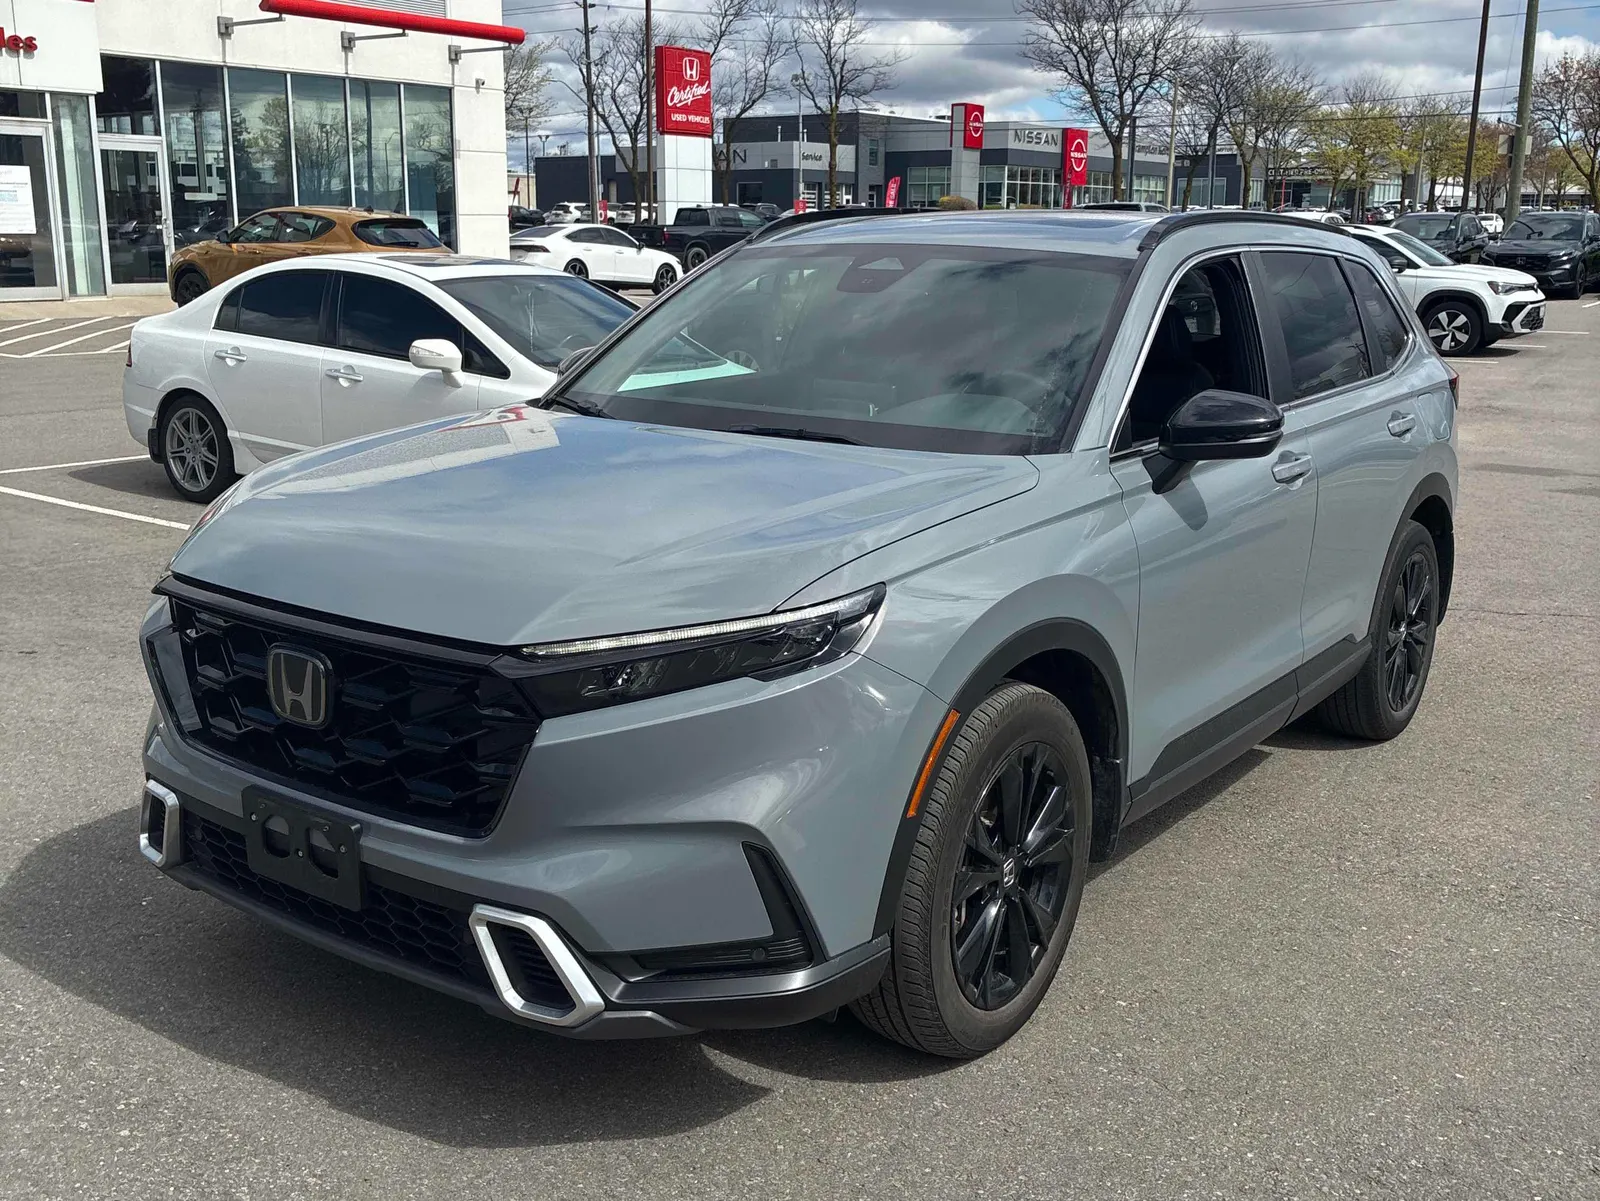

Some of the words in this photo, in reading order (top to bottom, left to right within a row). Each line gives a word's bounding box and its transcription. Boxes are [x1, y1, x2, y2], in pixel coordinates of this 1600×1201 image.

[667, 81, 711, 107] Certified
[671, 113, 687, 122] USED
[688, 114, 710, 124] VEHICLES
[1013, 129, 1059, 147] NISSAN
[801, 151, 823, 163] Service
[1070, 151, 1087, 159] NISSAN
[1268, 168, 1298, 176] CTIFIED
